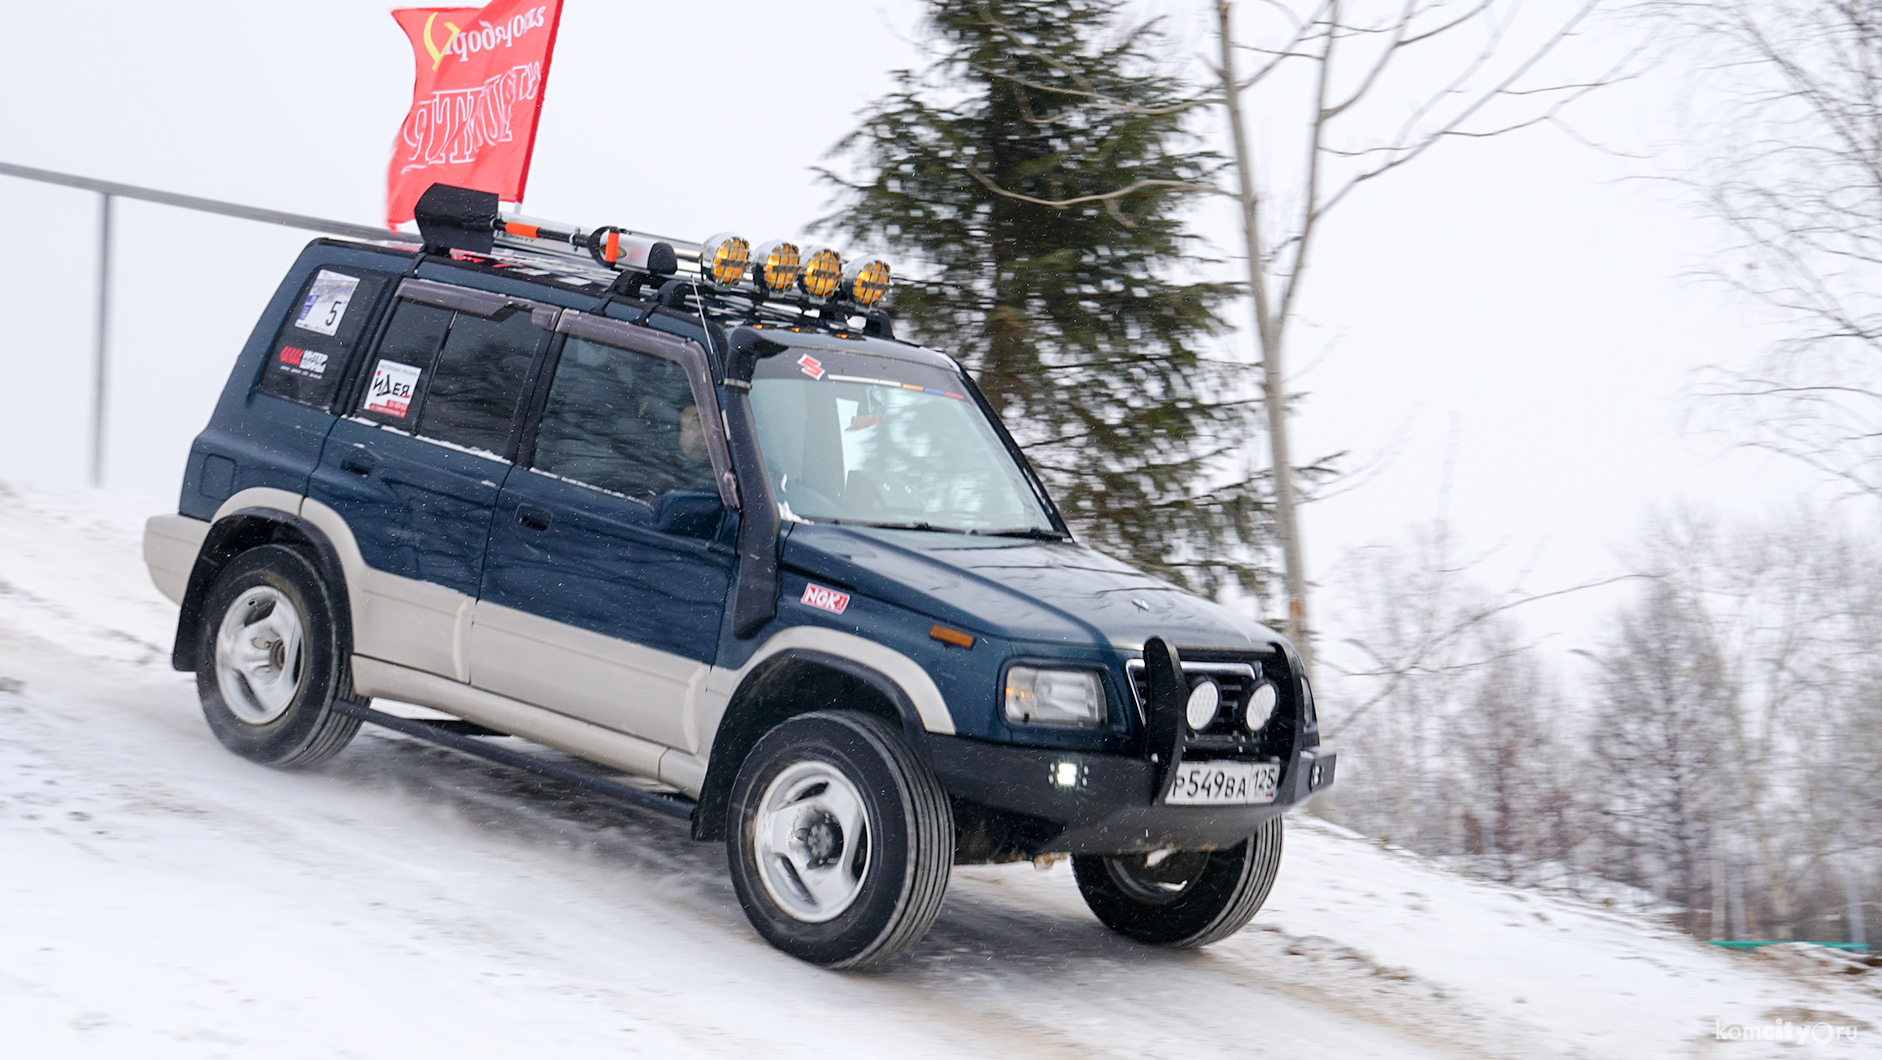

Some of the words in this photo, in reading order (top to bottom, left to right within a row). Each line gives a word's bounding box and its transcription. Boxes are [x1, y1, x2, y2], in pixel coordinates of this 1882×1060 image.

[325, 300, 342, 327] 5
[372, 373, 411, 398] ИДЕЯ
[1253, 768, 1276, 790] 125
